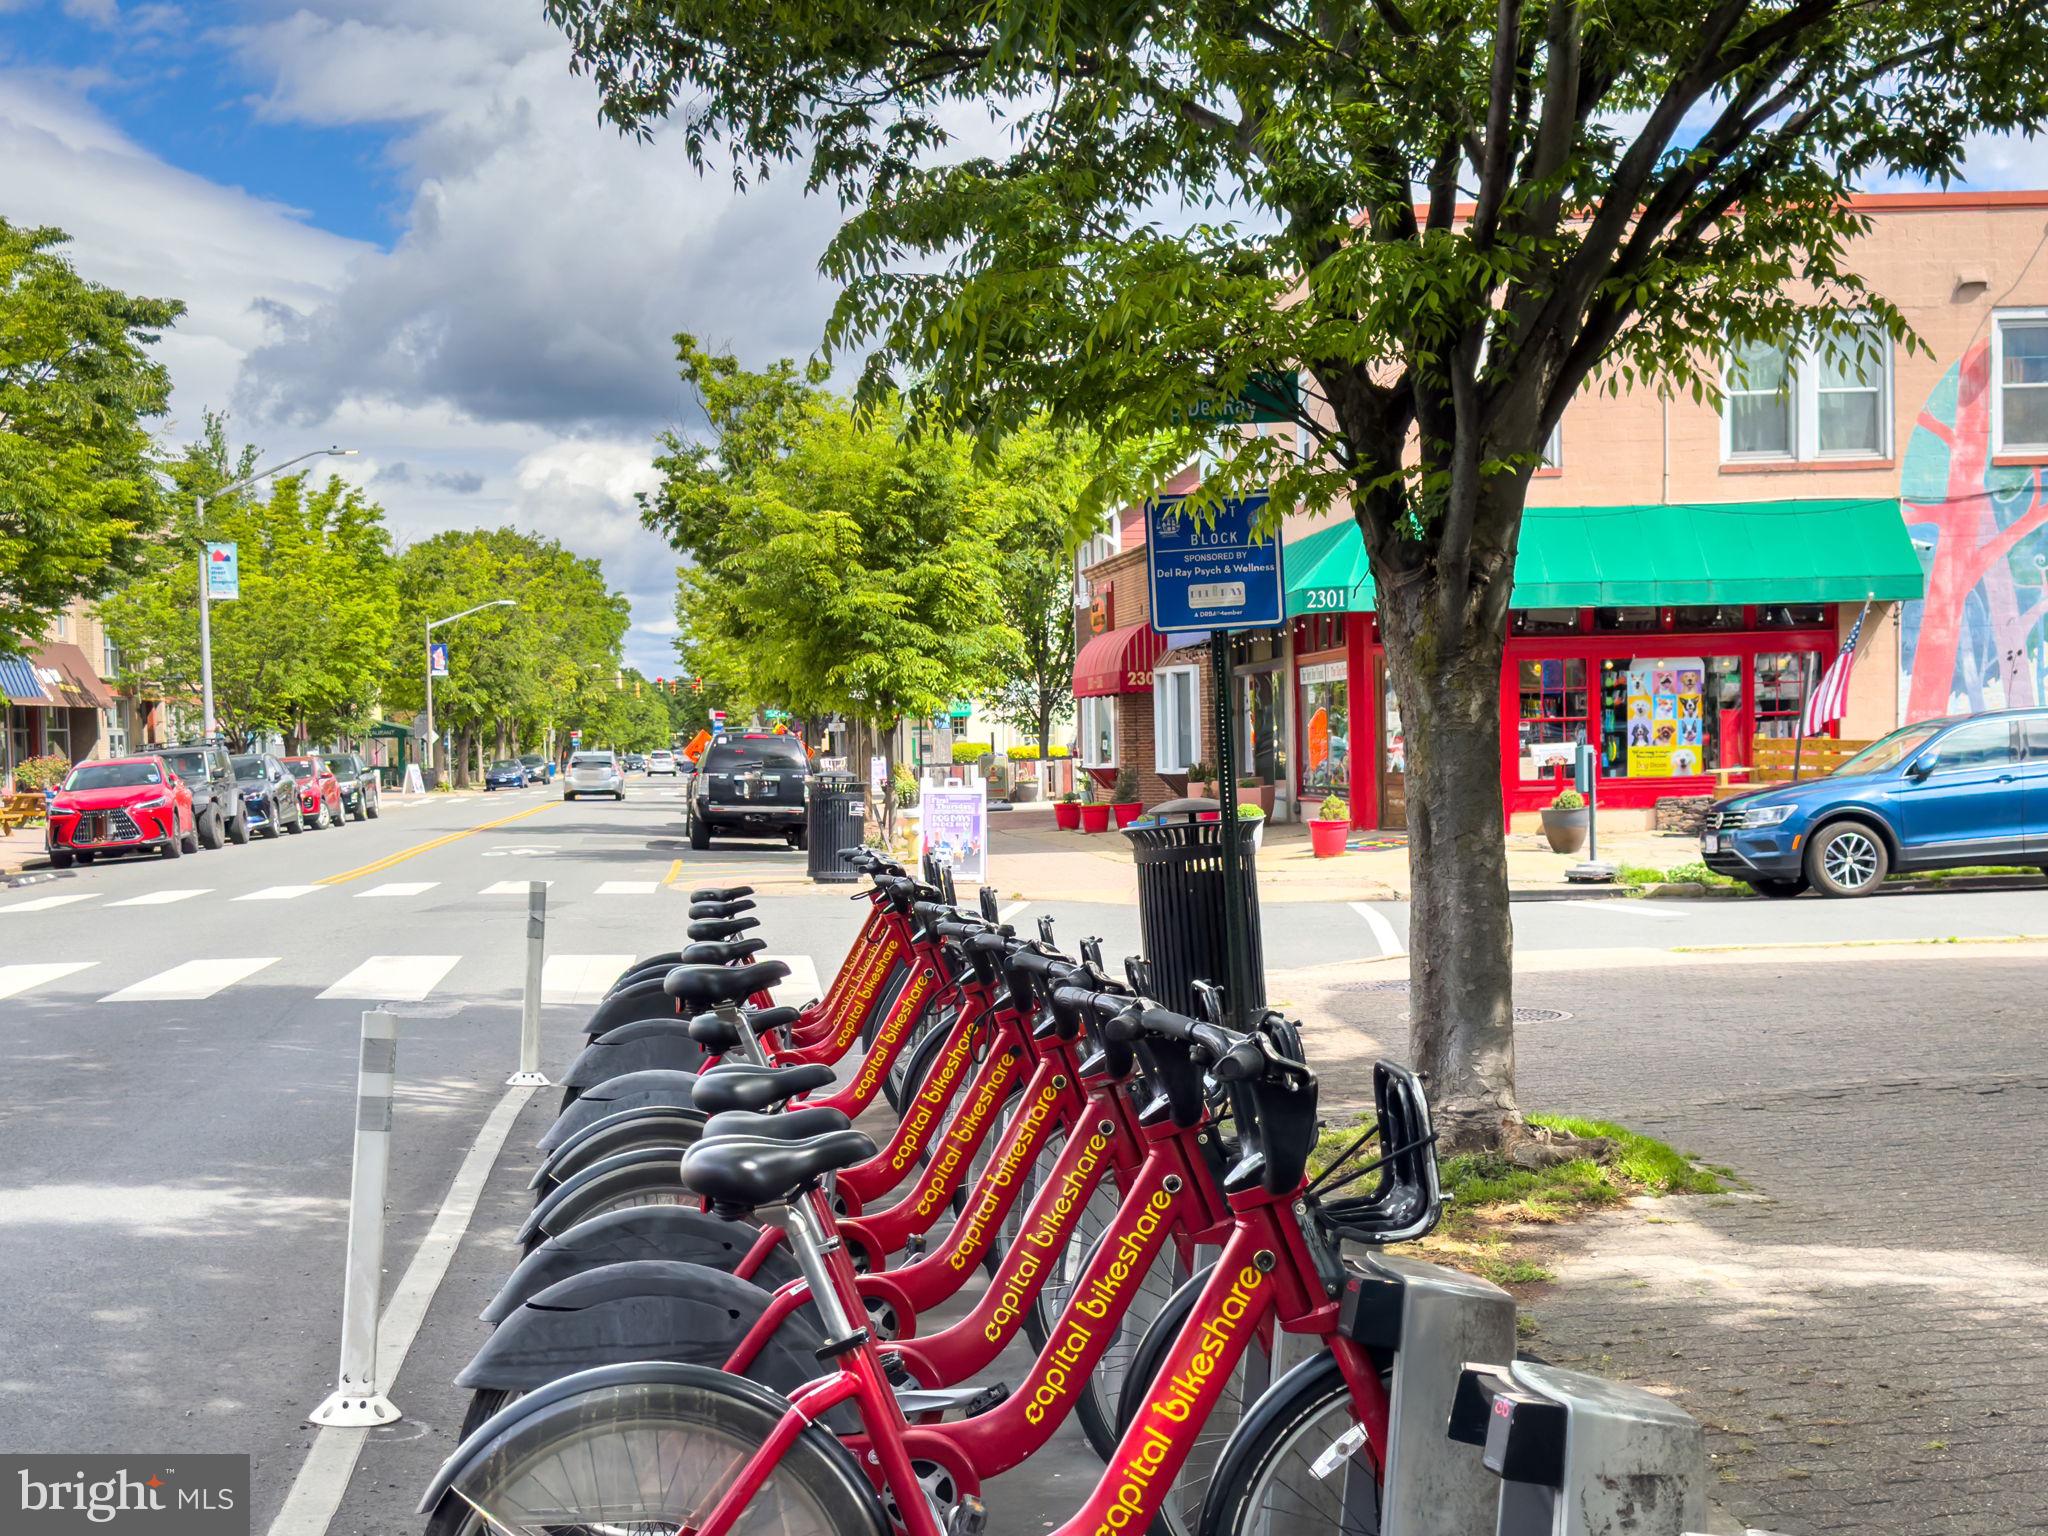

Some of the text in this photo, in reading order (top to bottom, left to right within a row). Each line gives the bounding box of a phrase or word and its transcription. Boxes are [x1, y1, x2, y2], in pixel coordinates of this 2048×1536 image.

[1157, 563, 1275, 579] Del Ray Psych & Wellness
[1183, 551, 1247, 563] SPONSORED BY
[1191, 531, 1238, 546] BLOCK
[1306, 589, 1345, 609] 2301
[837, 940, 898, 1048] capital bikeshare
[855, 976, 928, 1100] capital bikeshare
[892, 1023, 979, 1170] capital bikeshare
[916, 1053, 1015, 1216] capital bikeshare
[950, 1086, 1057, 1271] capital bikeshare
[984, 1135, 1107, 1343] capital bikeshare
[1025, 1190, 1171, 1424] capital bikeshare
[1152, 1266, 1262, 1422] bikeshare
